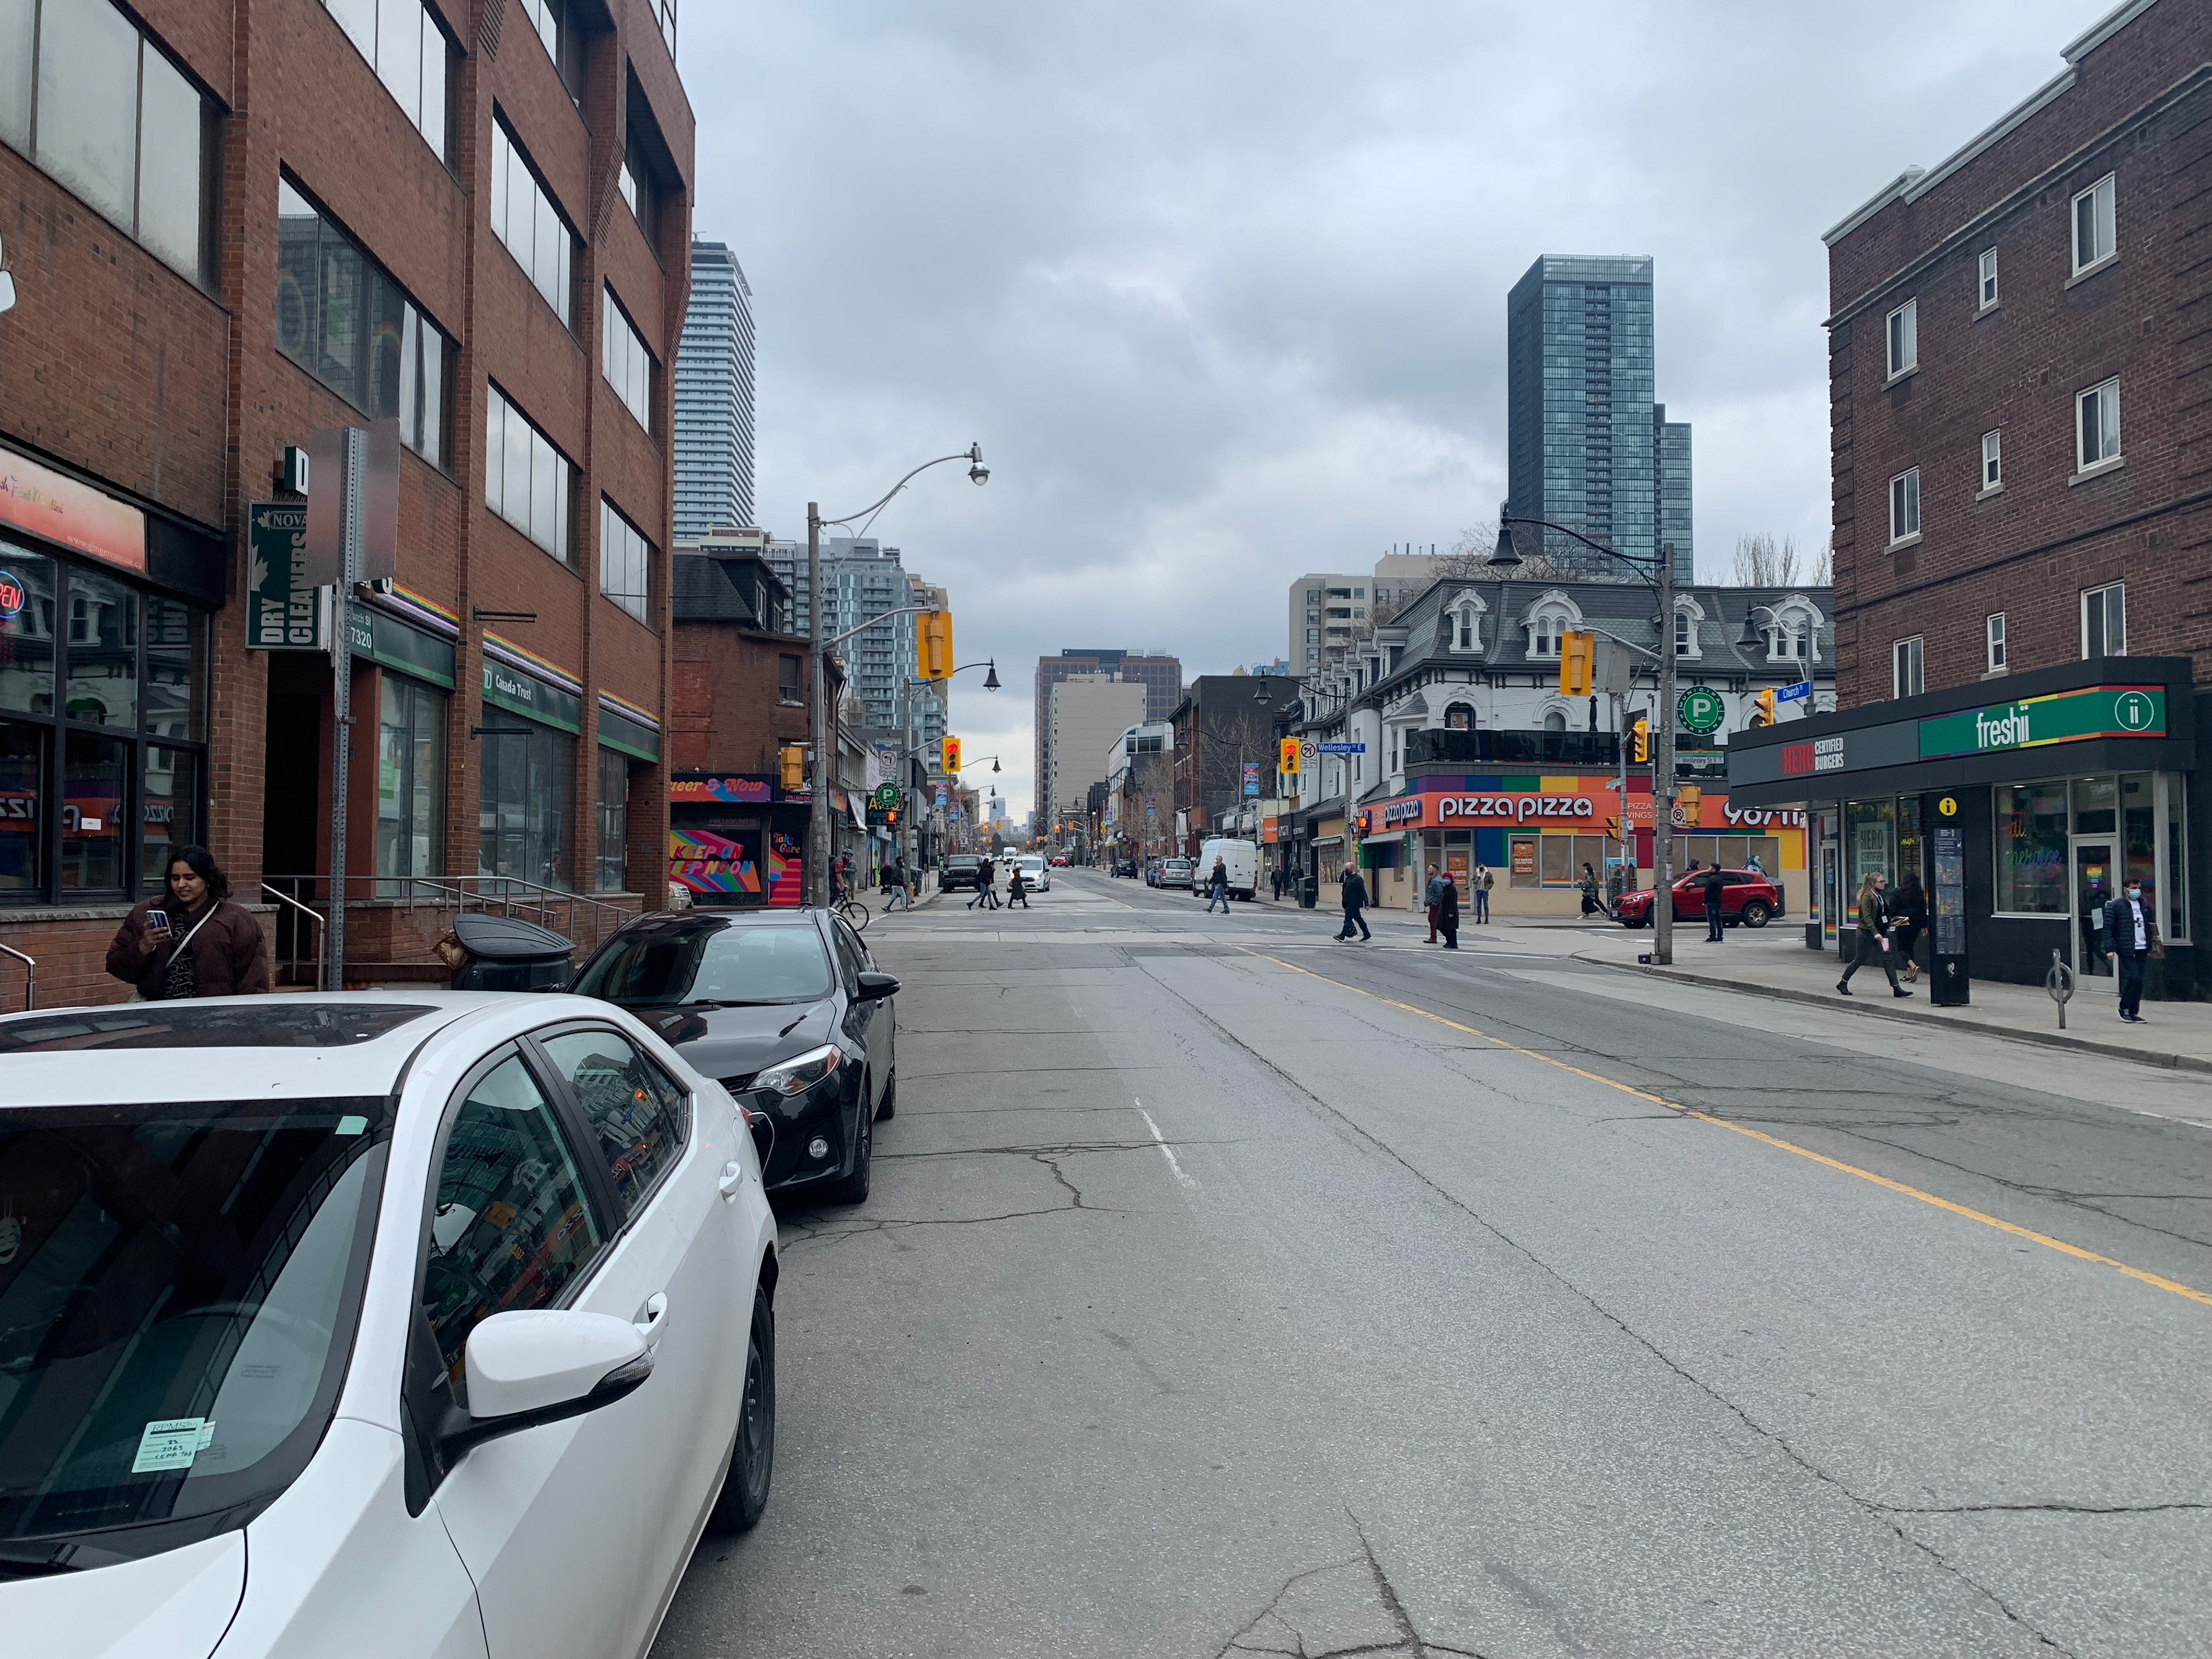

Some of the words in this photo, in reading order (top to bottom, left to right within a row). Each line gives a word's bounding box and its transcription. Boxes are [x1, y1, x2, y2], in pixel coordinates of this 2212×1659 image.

[289, 532, 313, 644] CLEANERS
[260, 598, 285, 643] DRY
[353, 612, 364, 624] urch
[351, 627, 372, 649] 7320
[496, 674, 516, 695] Canada
[517, 683, 532, 701] Trust
[1783, 688, 1799, 699] Church
[1679, 687, 1722, 709] MUNICIPAL
[1693, 698, 1711, 718] P
[1679, 714, 1723, 734] PARKING
[1976, 704, 2029, 748] freshii
[1318, 744, 1351, 753] Wellesley
[1815, 737, 1843, 755] CERTIFIED
[1783, 742, 1814, 775] HERO
[1815, 753, 1844, 771] BURGERS
[670, 780, 702, 793] ueer
[724, 779, 763, 793] Now
[1384, 803, 1400, 828] pizza
[1400, 800, 1418, 826] pizza
[1438, 797, 1513, 823] pizza
[1518, 797, 1593, 823] pizza
[773, 832, 795, 844] Take
[779, 842, 801, 854] Care
[1860, 830, 1884, 850] HERO
[673, 844, 717, 859] KEEP
[721, 844, 744, 859] ON
[729, 861, 754, 875] ON
[153, 1422, 185, 1432] RPMS
